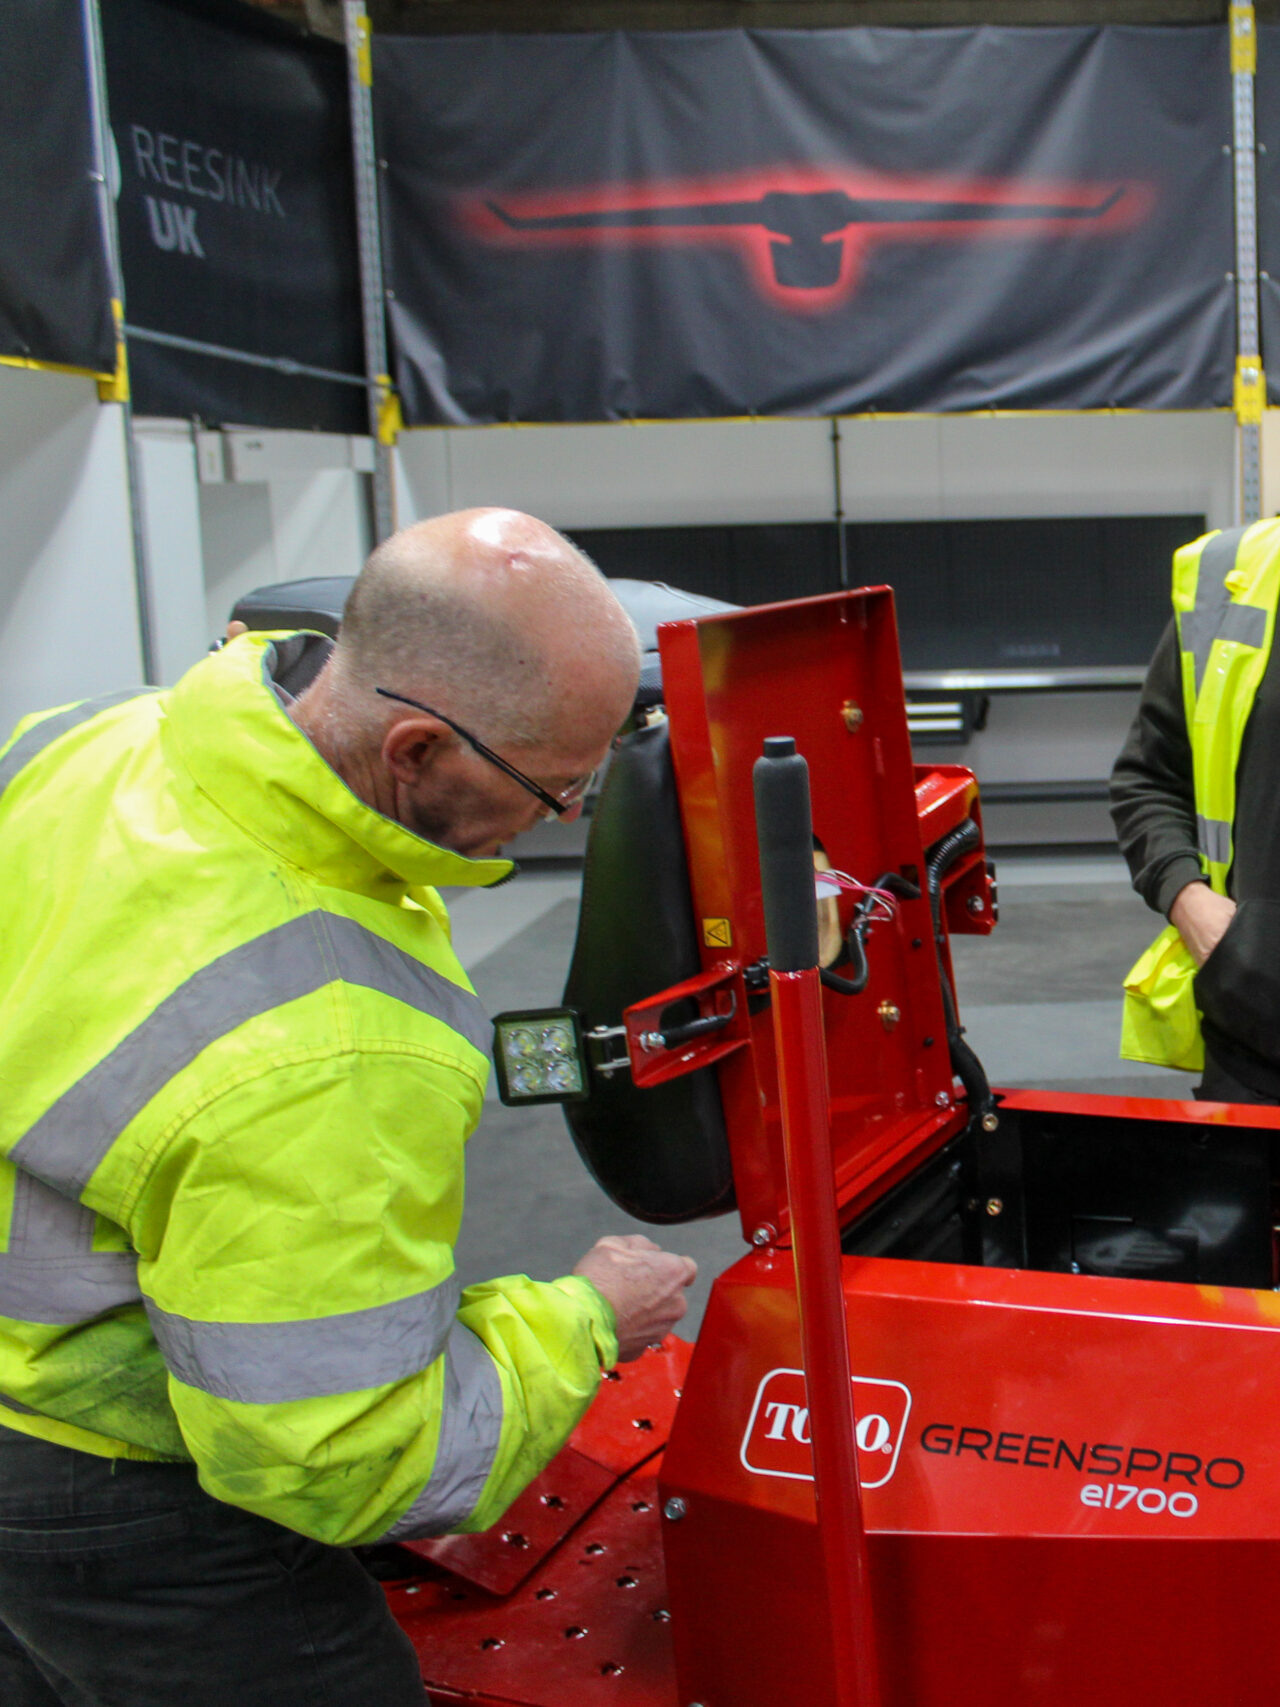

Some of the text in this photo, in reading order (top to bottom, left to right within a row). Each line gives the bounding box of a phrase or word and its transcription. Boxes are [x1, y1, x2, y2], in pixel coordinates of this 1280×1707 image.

[131, 123, 286, 218] REESINK
[145, 194, 206, 259] UK
[764, 1401, 891, 1453] TOO
[919, 1423, 1246, 1490] GREENSPRO
